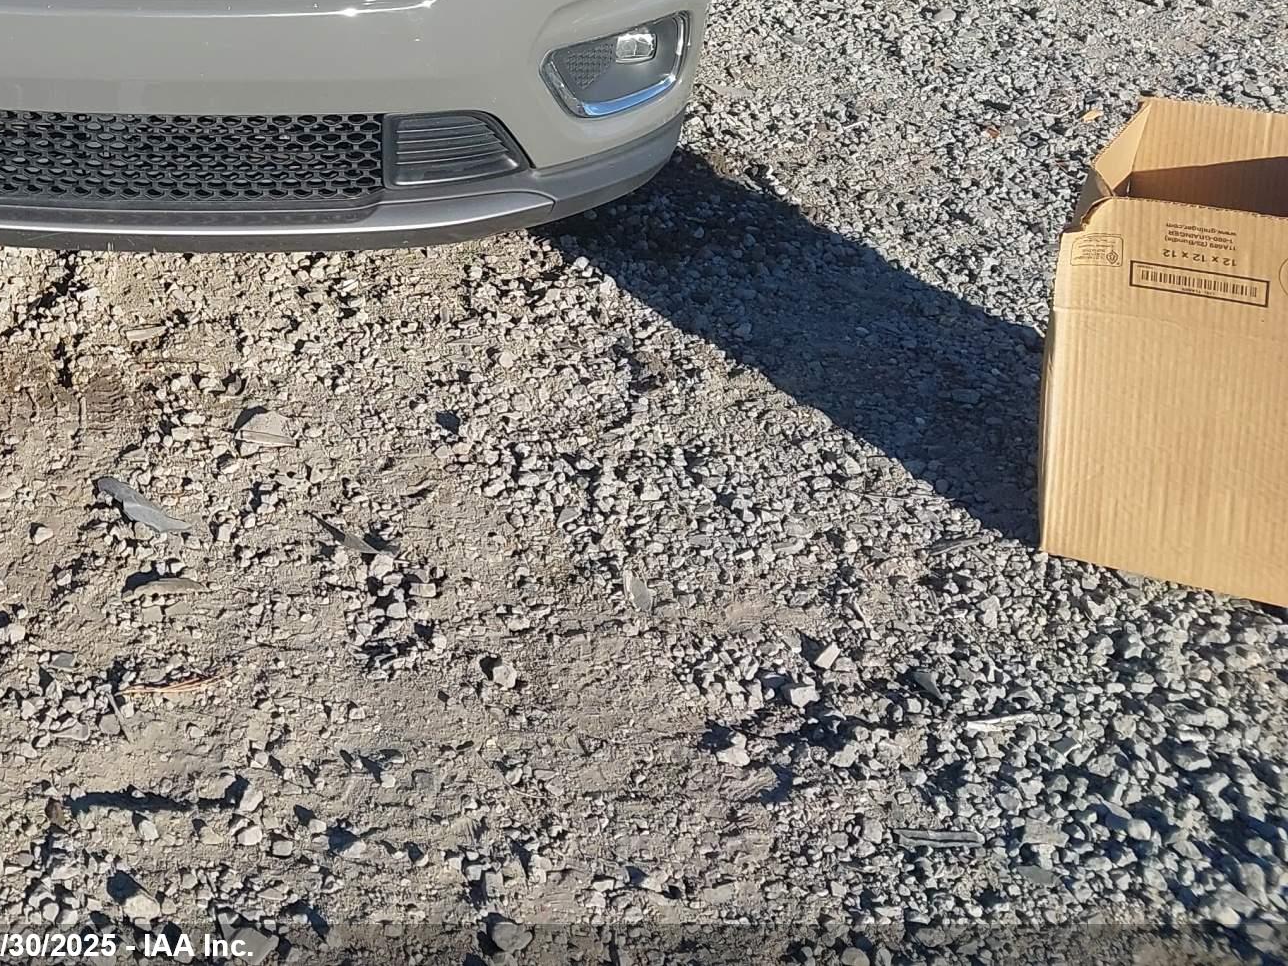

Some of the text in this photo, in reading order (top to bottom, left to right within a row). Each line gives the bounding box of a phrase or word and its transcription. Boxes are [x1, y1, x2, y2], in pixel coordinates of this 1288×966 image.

[1162, 249, 1176, 258] 12
[1193, 253, 1206, 262] 12
[1223, 257, 1237, 267] 12
